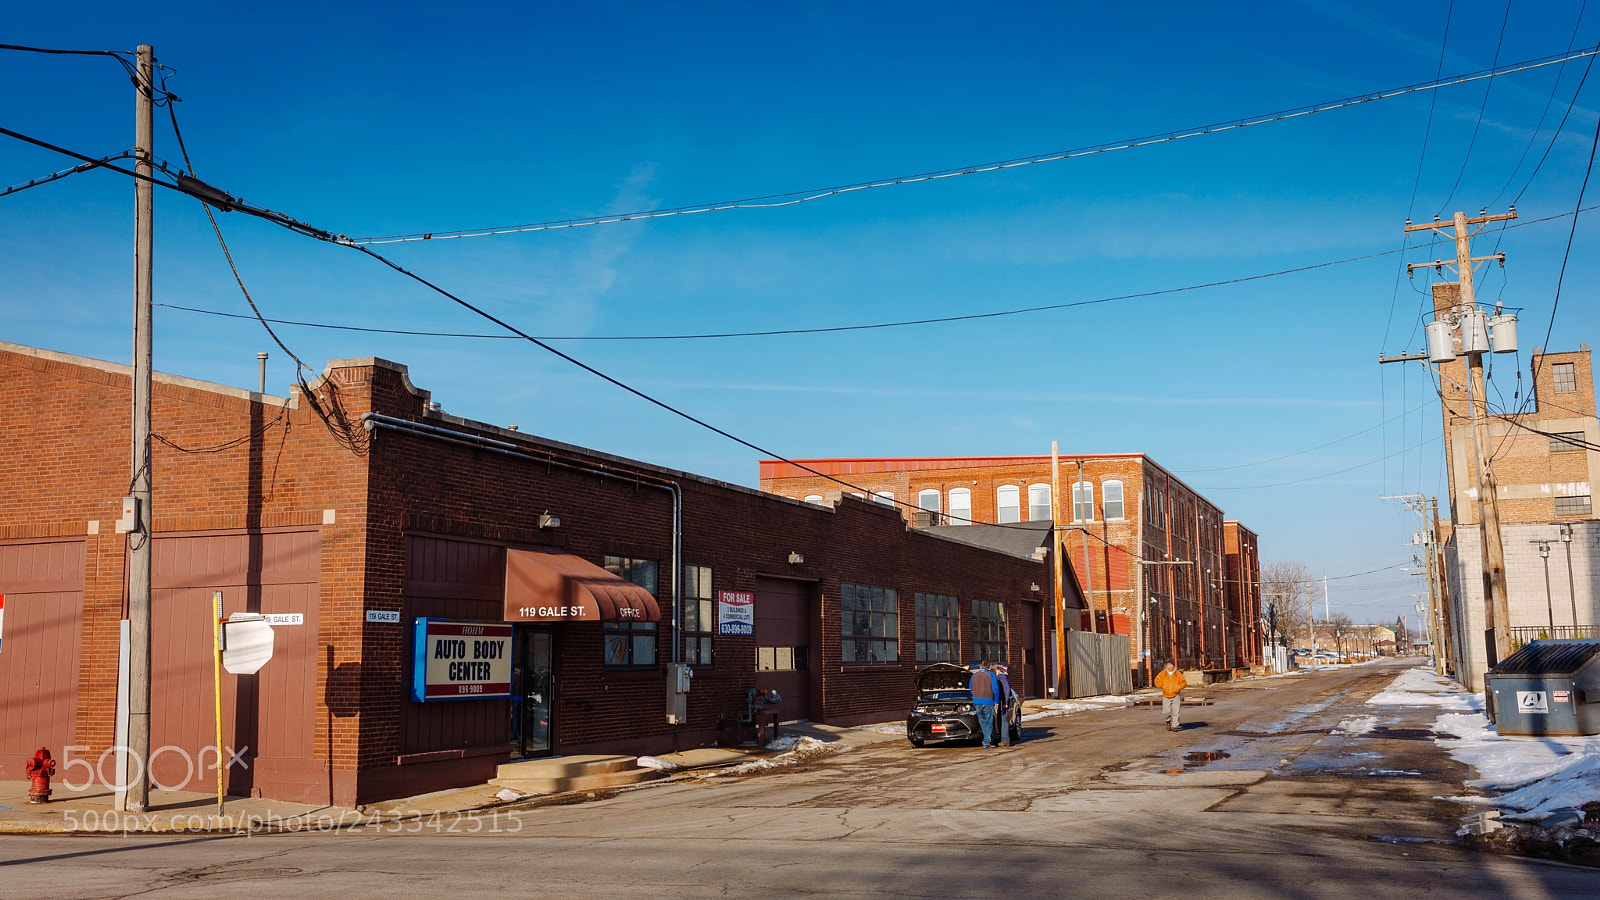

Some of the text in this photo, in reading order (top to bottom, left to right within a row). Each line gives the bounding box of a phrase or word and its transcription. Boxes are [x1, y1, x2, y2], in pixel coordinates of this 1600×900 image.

[723, 592, 750, 603] FOR SALE
[391, 613, 399, 621] ST.
[519, 606, 586, 617] 119 GALE ST.
[620, 607, 641, 618] OFFICE
[461, 626, 484, 635] HOHM
[434, 639, 504, 659] AUTO BODY
[448, 661, 491, 681] CENTER
